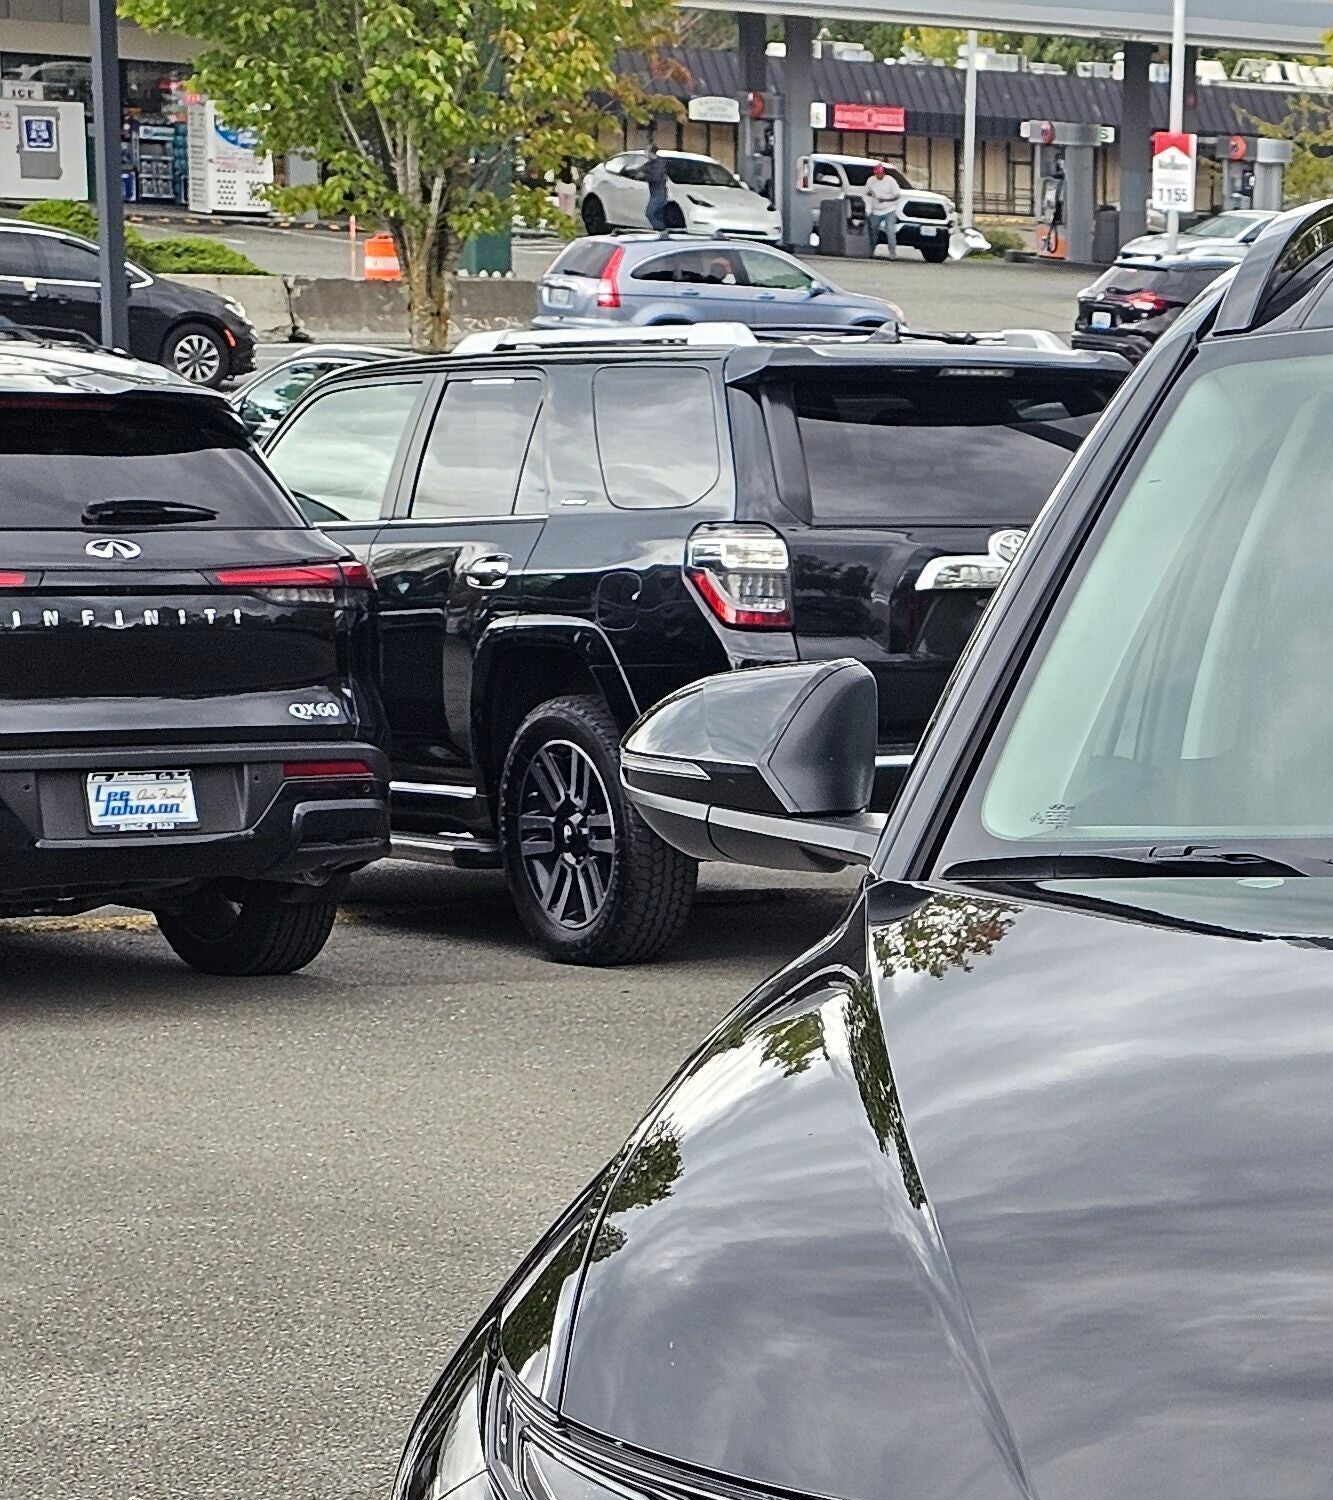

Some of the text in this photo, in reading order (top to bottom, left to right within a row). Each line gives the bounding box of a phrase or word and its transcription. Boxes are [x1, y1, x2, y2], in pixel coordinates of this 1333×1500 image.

[12, 608, 241, 627] INFINITI
[289, 703, 340, 719] QX60
[96, 785, 133, 802] Lee
[98, 798, 183, 817] Johnson
